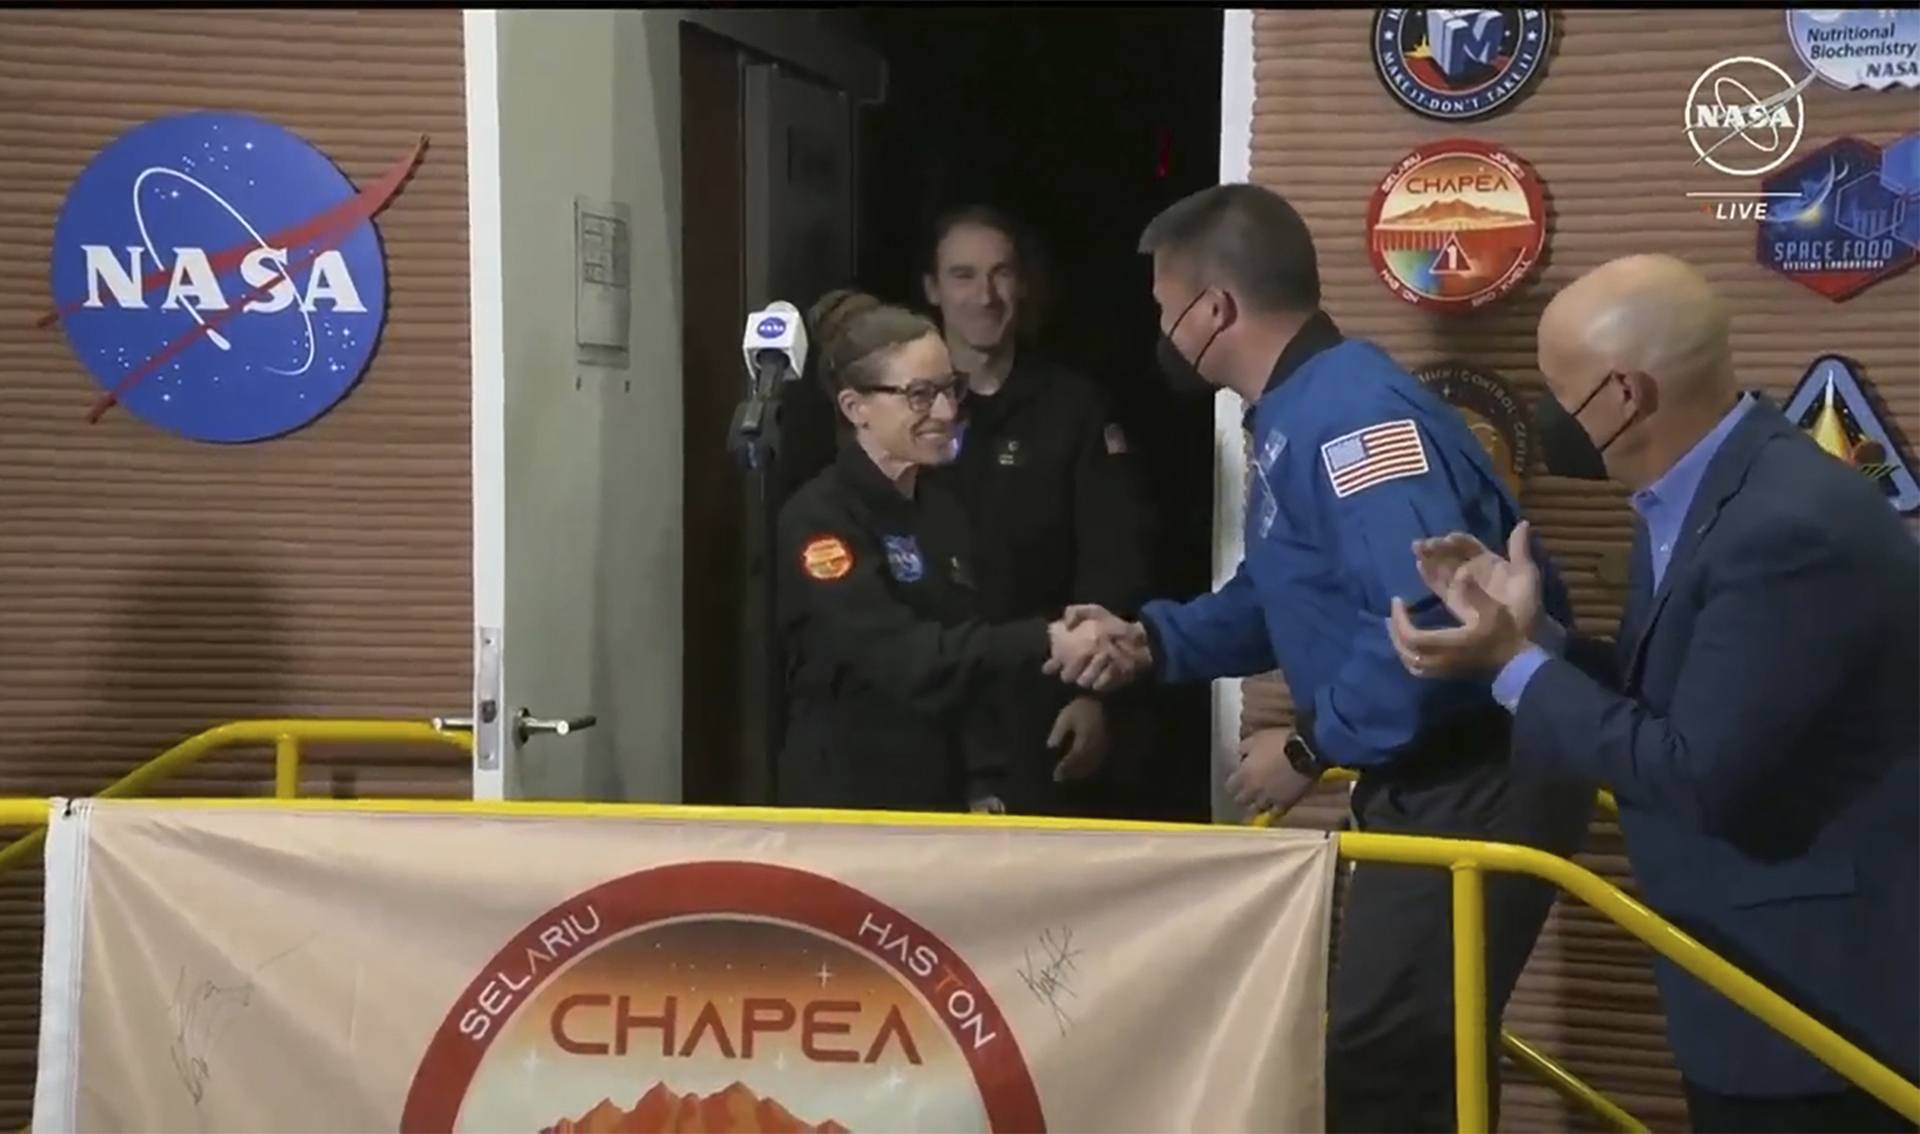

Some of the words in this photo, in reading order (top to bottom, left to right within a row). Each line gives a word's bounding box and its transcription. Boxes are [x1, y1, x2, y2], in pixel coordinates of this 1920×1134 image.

[1807, 22, 1895, 42] Nutritional
[1810, 41, 1917, 60] Biochemistry
[1383, 51, 1411, 91] MAKE
[1429, 98, 1479, 112] DON'T
[1487, 71, 1521, 101] TAKE
[1866, 61, 1918, 77] NASA
[1406, 175, 1509, 194] CHAPEA
[1446, 244, 1457, 270] 1
[1774, 240, 1834, 261] SPACE
[1843, 239, 1893, 259] FOOD
[80, 244, 368, 314] NASA
[459, 905, 600, 1040] SELARIU
[858, 912, 997, 1049] HASTON
[551, 993, 923, 1066] CHAPEA
